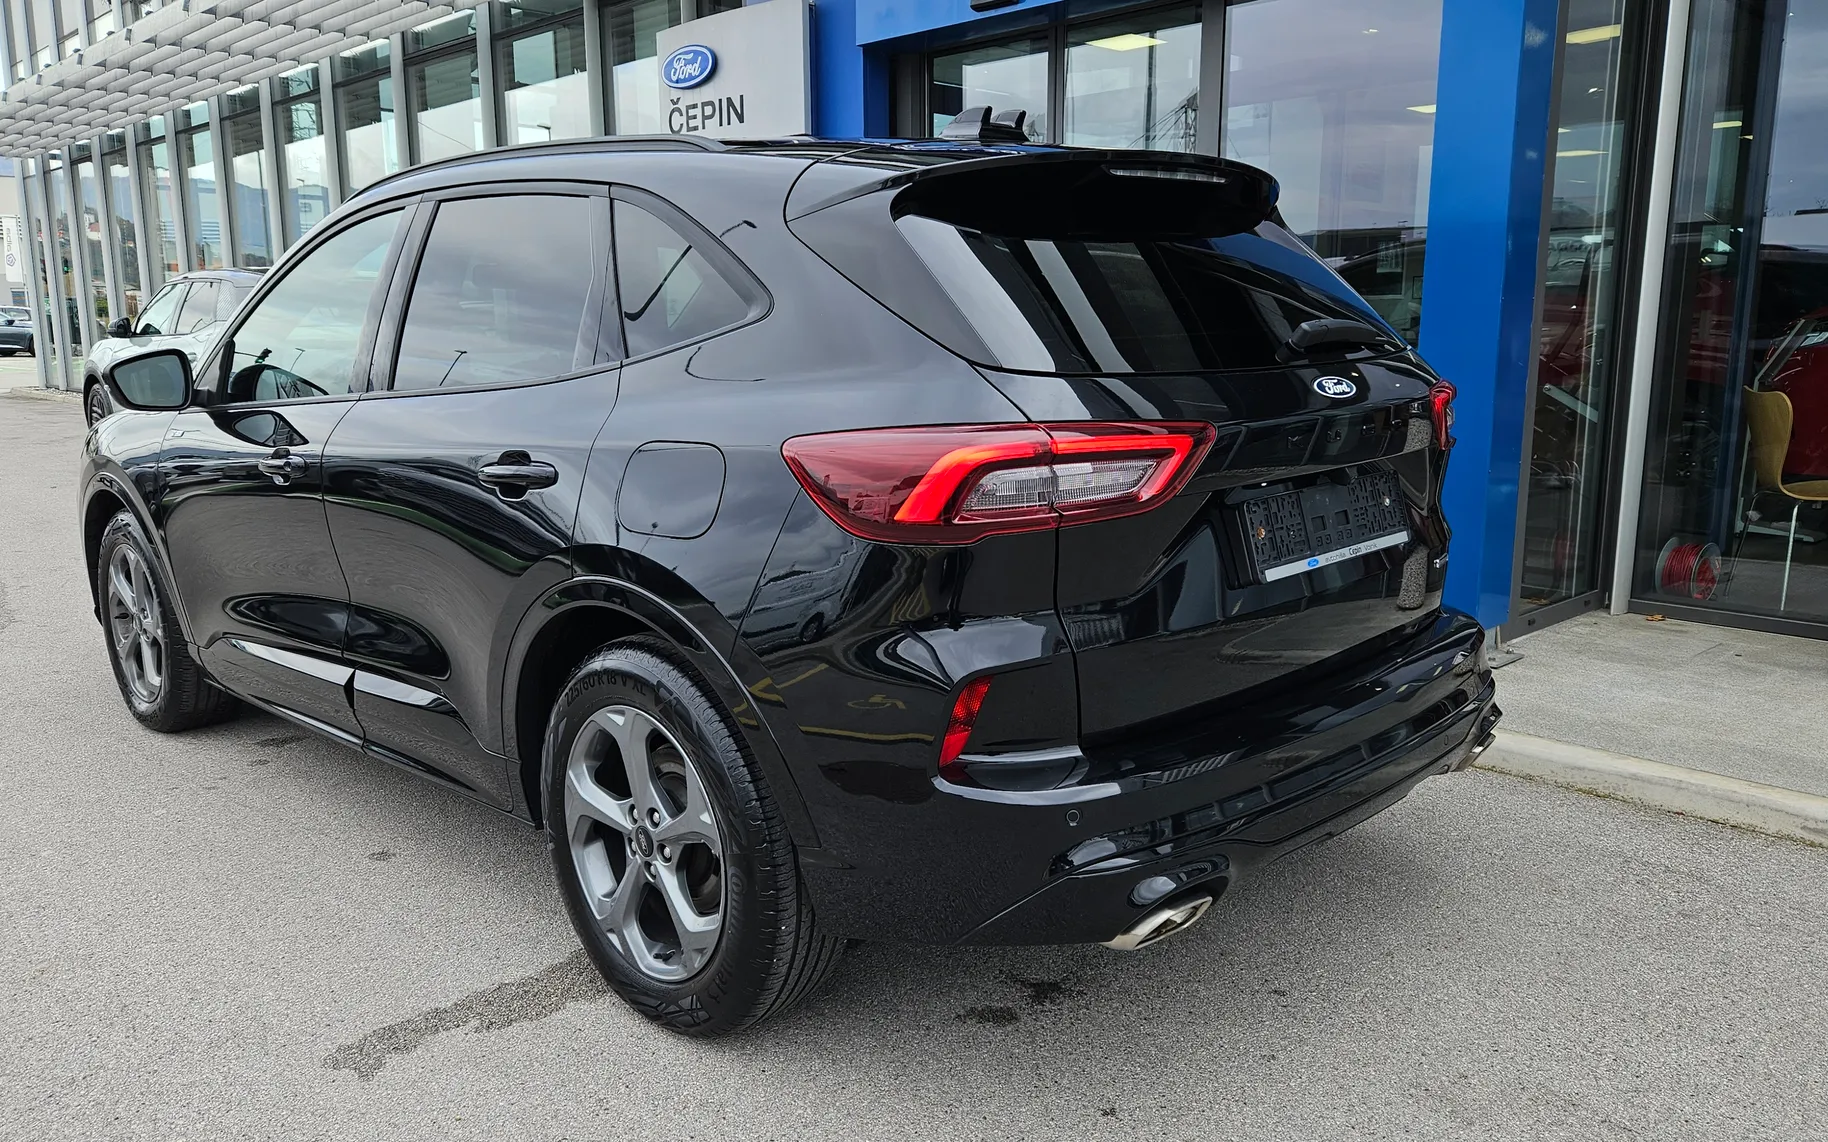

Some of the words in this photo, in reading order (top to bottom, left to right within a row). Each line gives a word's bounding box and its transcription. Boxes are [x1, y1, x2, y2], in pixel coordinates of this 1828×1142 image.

[671, 53, 701, 82] Ford
[668, 95, 745, 134] ČEPIN
[1322, 379, 1351, 394] Ford
[565, 670, 596, 708] 225/60
